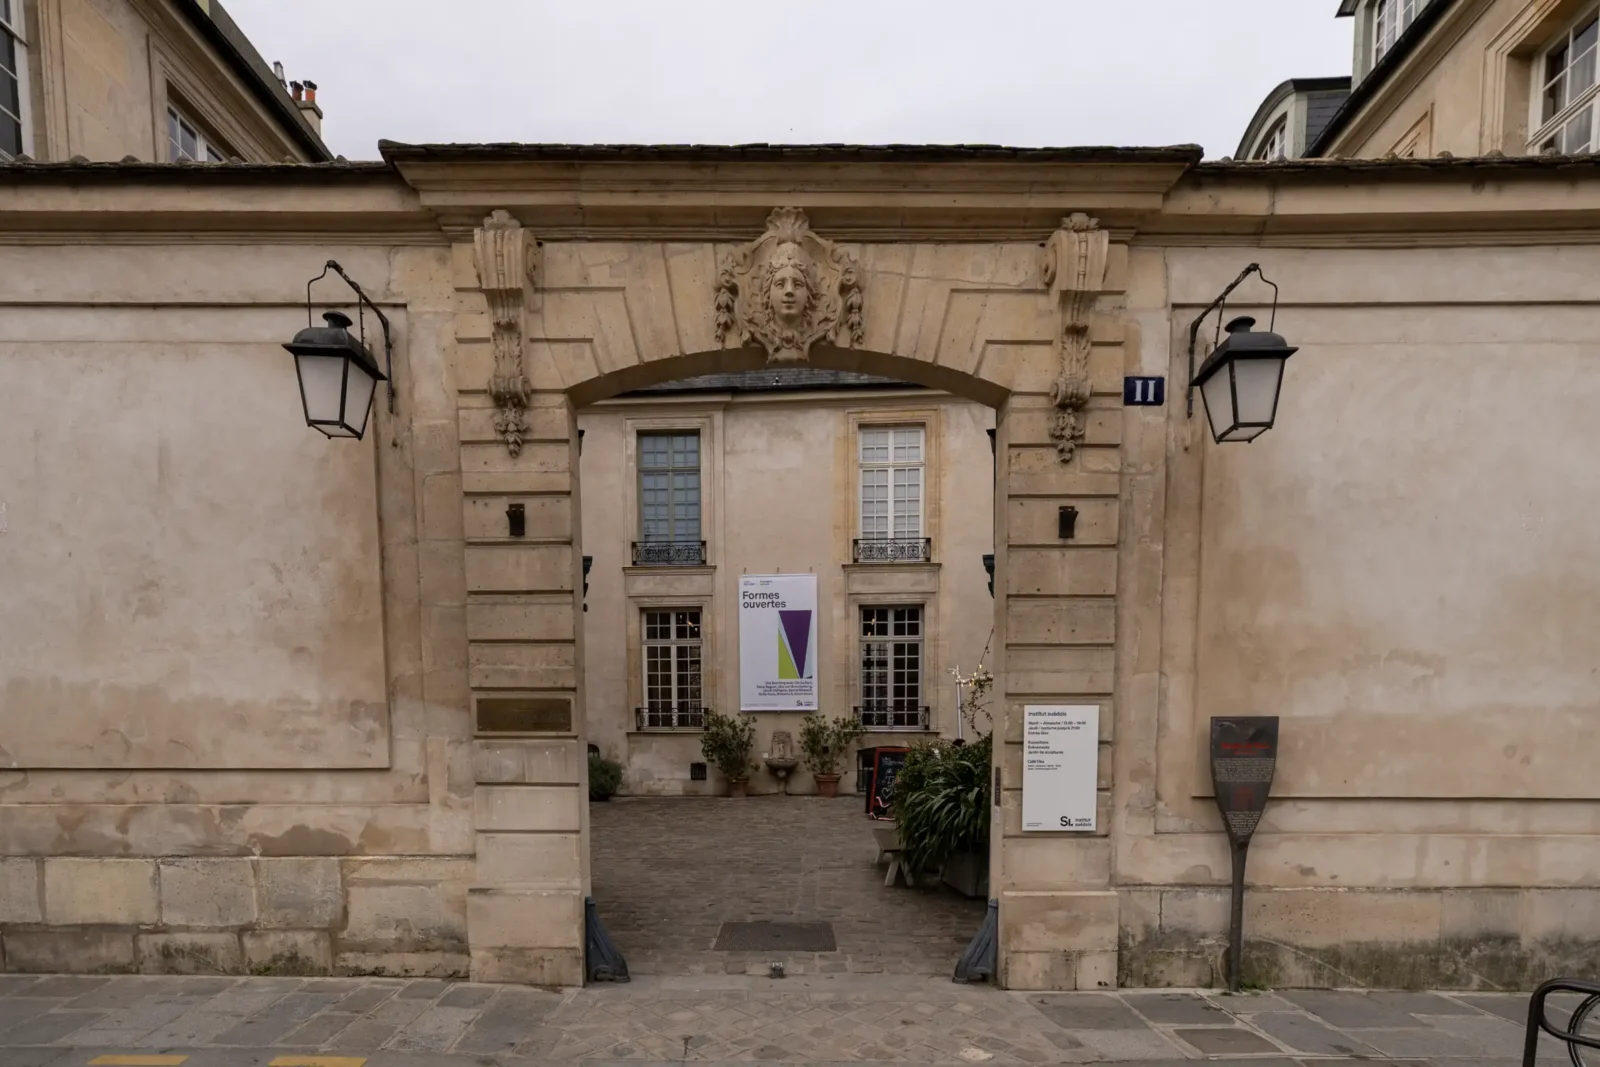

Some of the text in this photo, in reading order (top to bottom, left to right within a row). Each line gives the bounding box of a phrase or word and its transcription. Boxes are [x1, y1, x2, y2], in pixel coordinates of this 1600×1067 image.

[1134, 380, 1156, 402] 11
[743, 591, 779, 600] Formes
[743, 600, 786, 609] ouvertes
